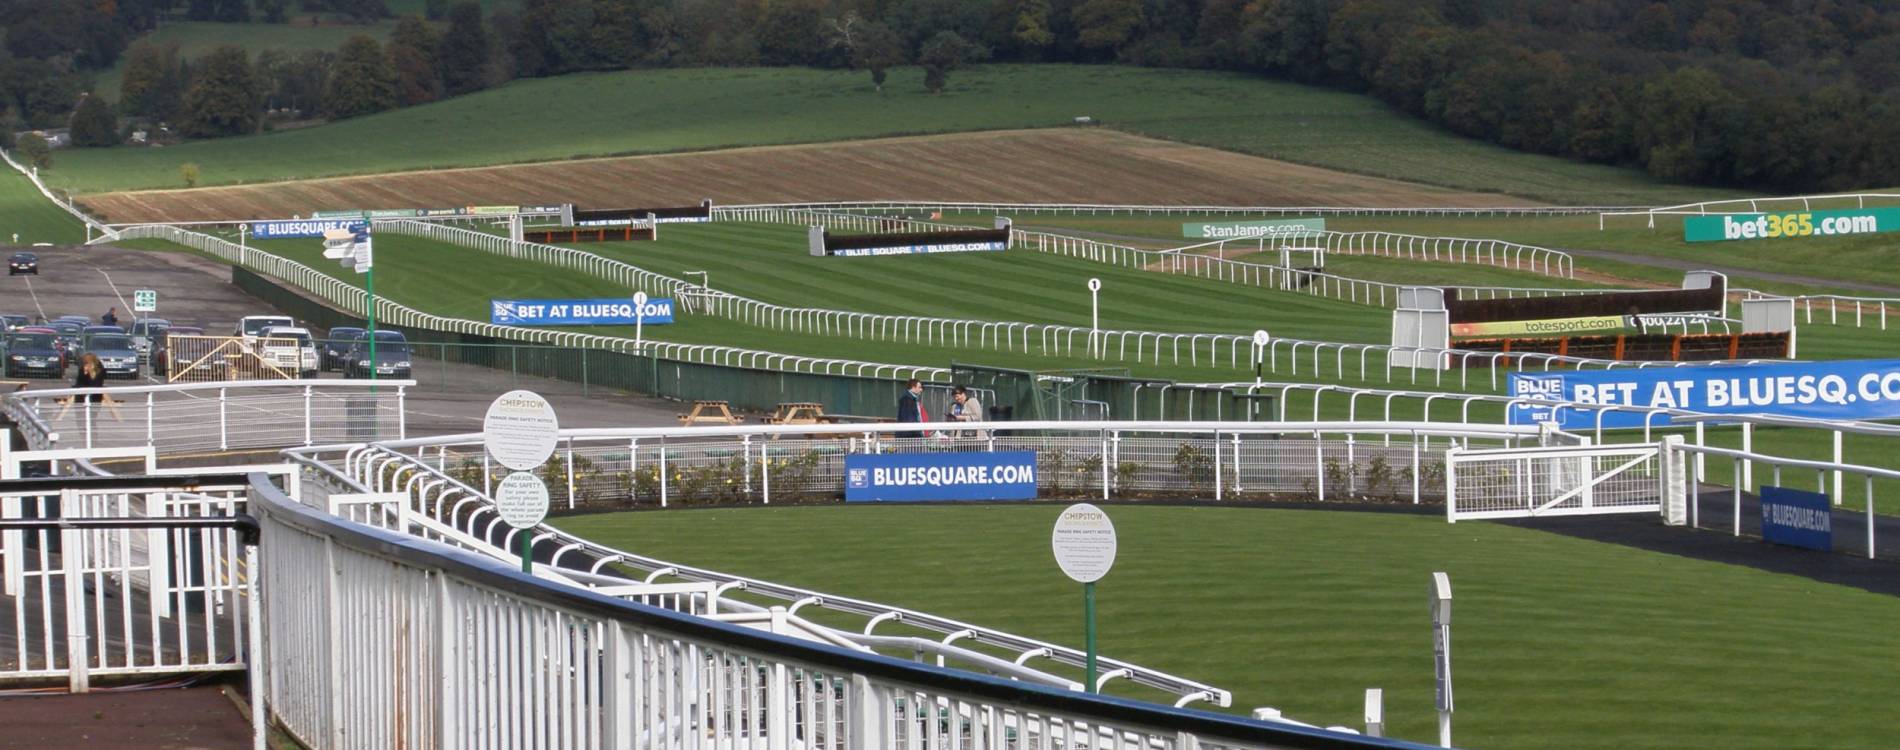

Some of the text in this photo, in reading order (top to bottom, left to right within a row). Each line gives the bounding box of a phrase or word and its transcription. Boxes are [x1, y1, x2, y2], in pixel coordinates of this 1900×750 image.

[1202, 224, 1305, 237] StanJames.com
[1724, 213, 1877, 239] bet365.com
[872, 246, 912, 256] SQUARE
[928, 242, 991, 253] BLUESQ.COM
[518, 304, 671, 318] BET AT BLUESQ.COM
[1526, 317, 1616, 334] totesport.com
[1517, 380, 1561, 394] BLUE
[1574, 382, 1638, 412] BET
[1650, 380, 1694, 408] AT
[500, 400, 545, 409] CHEPSTOW
[1532, 412, 1548, 420] BET
[874, 465, 1034, 486] BLUESQUARE.COM
[1064, 512, 1103, 520] CHEPSTOW
[1772, 504, 1831, 532] BLUESQUARE.COM
